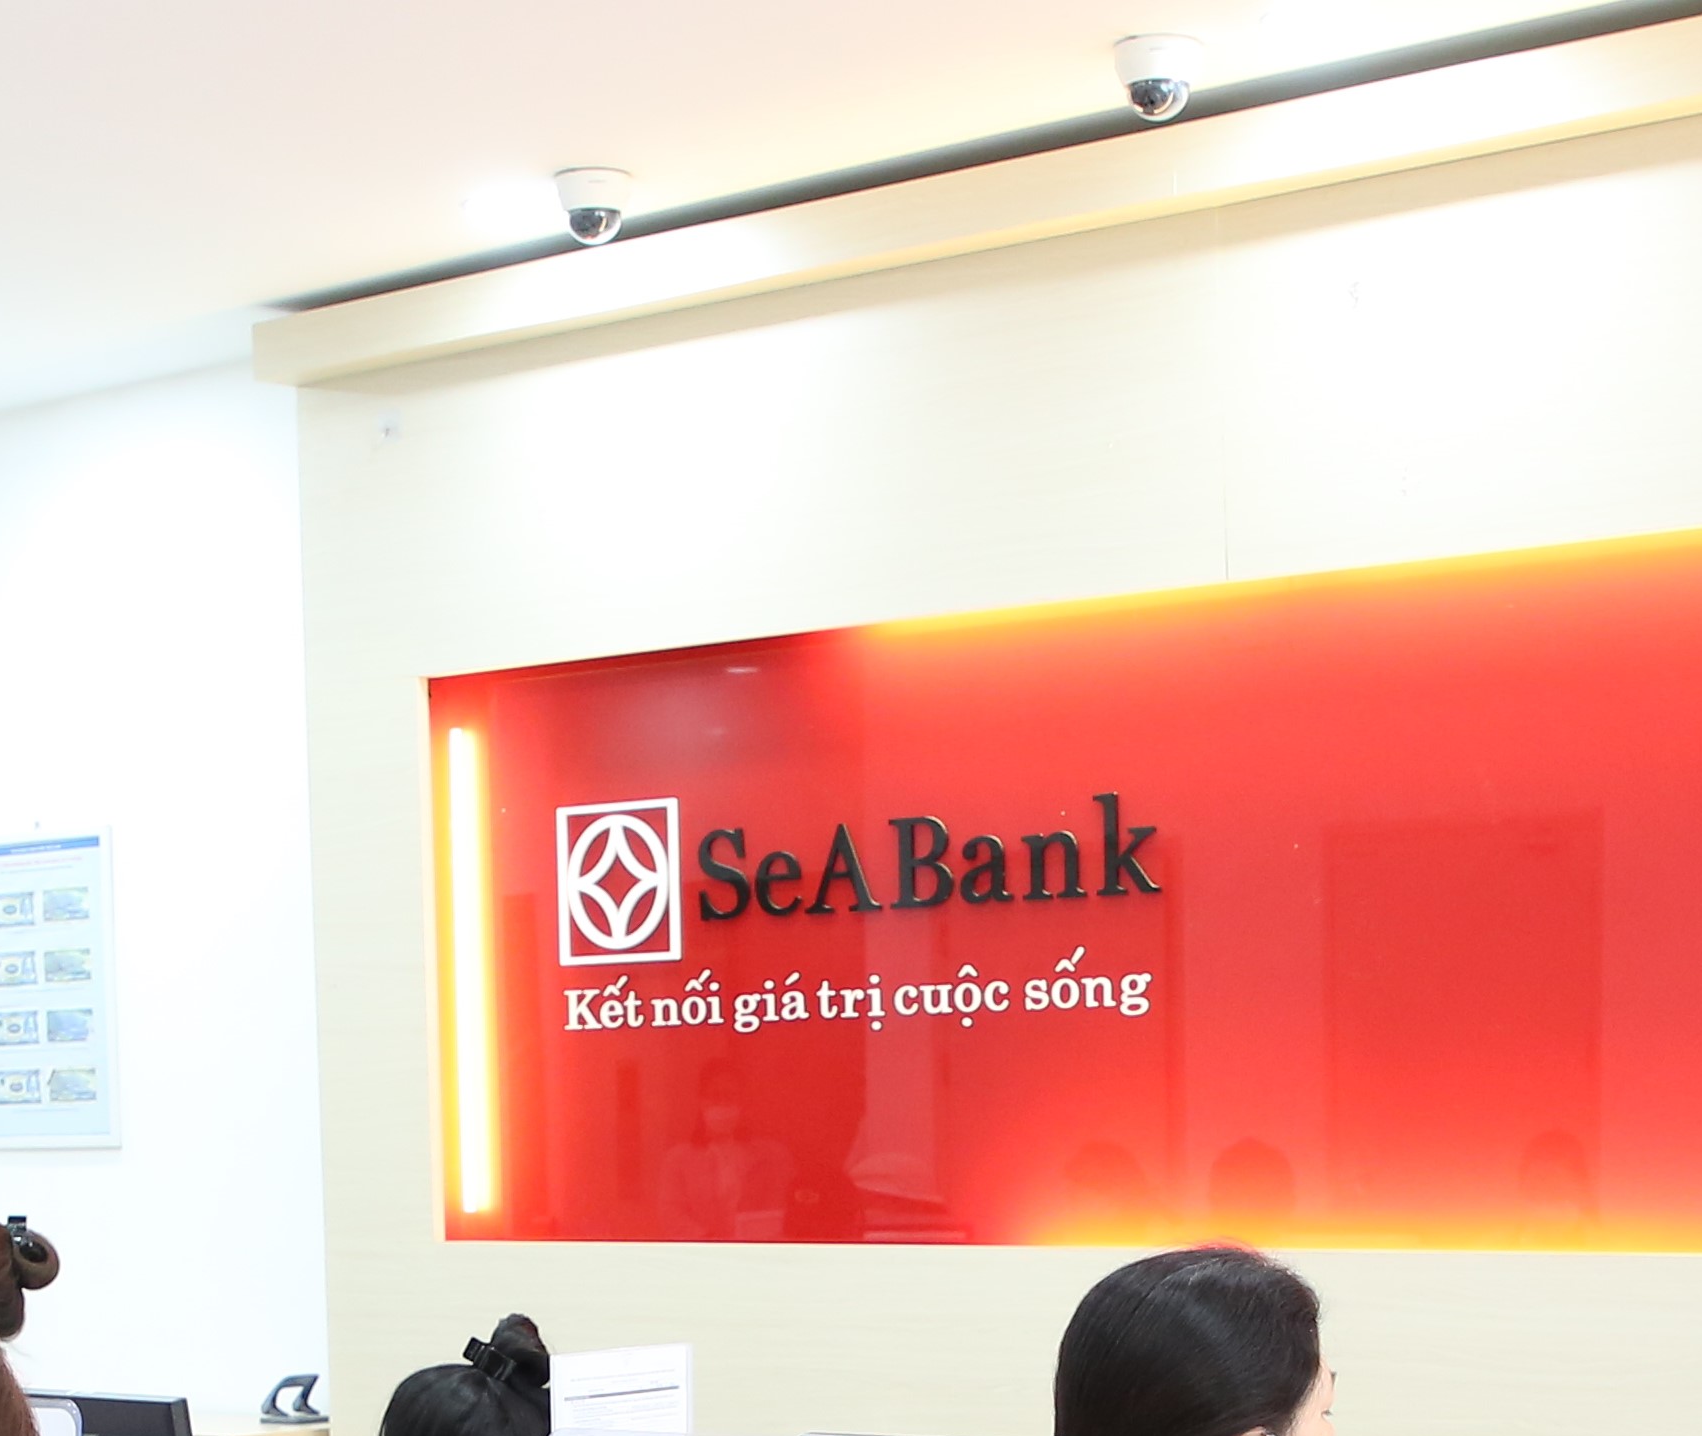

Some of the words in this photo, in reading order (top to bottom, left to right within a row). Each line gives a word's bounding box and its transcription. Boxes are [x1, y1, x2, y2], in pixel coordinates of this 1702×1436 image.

[699, 792, 1163, 922] SeABank
[564, 976, 643, 1031] Kết
[652, 969, 724, 1026] nối
[733, 972, 808, 1033] giá
[817, 974, 886, 1031] trị
[894, 964, 1009, 1028] cuộc
[1023, 946, 1152, 1016] sống
